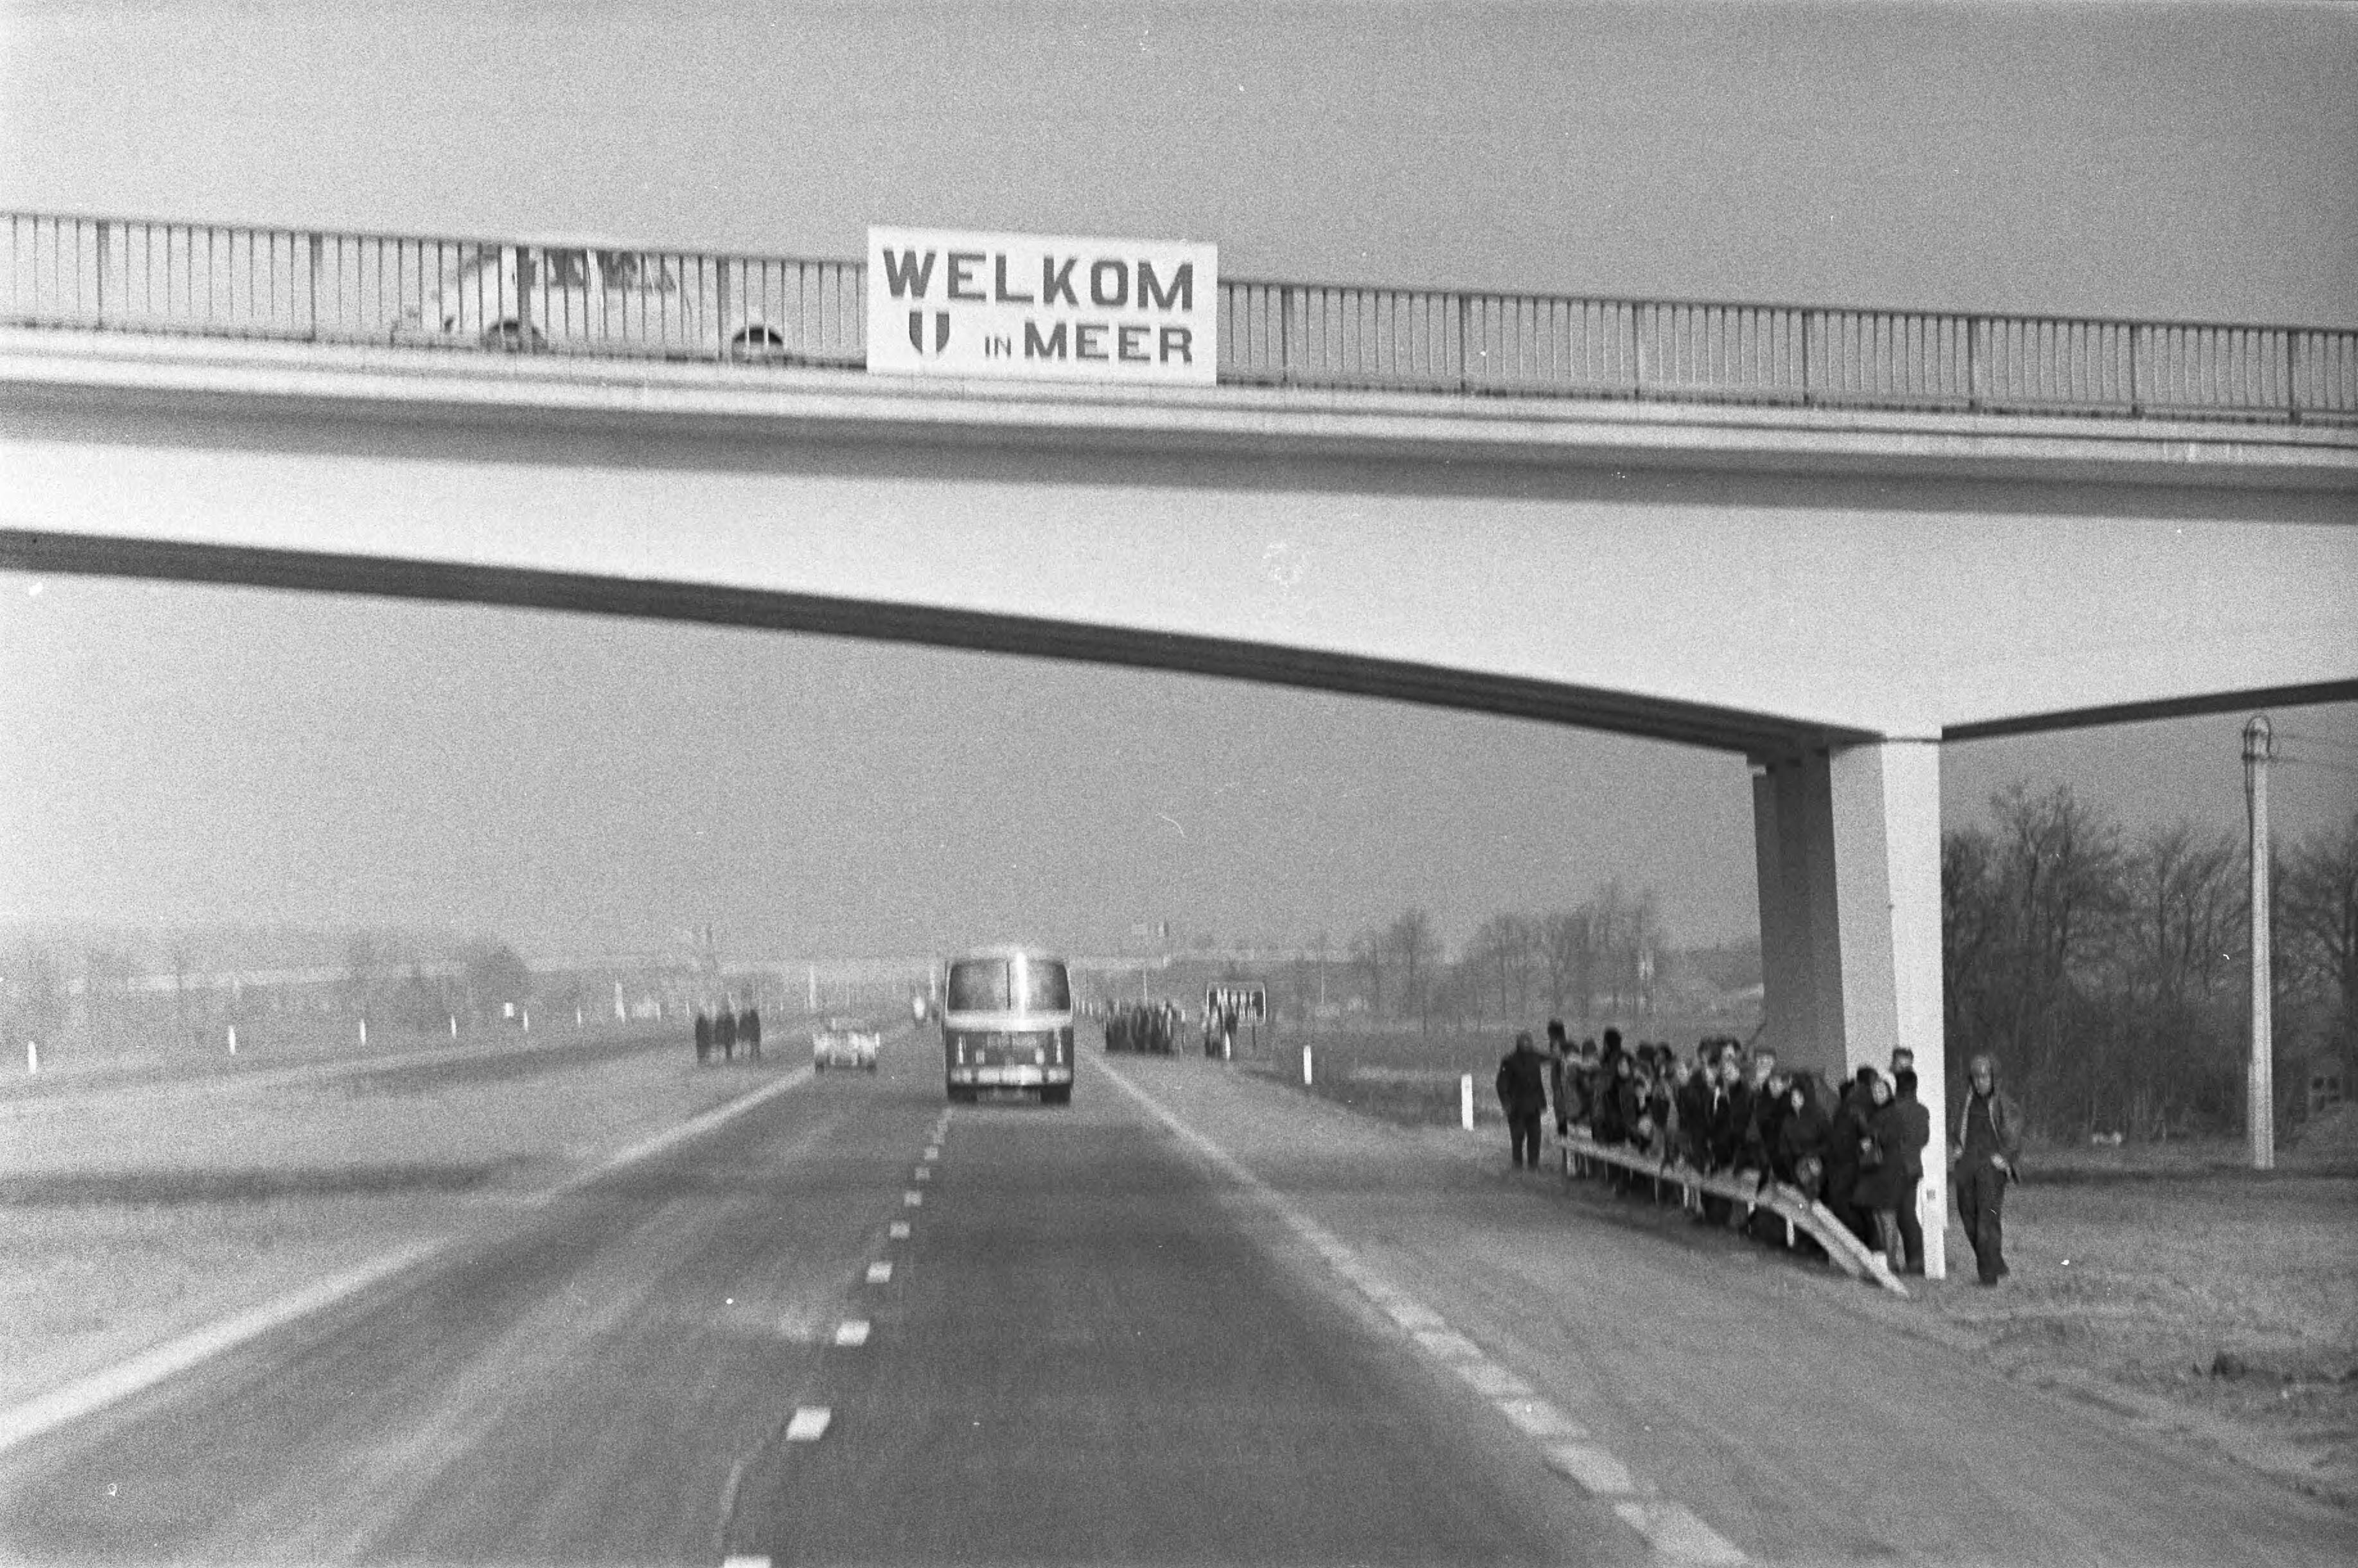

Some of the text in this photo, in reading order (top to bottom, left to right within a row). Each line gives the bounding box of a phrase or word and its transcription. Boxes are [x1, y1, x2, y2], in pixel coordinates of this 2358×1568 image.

[883, 248, 1193, 311] WELKOM
[985, 336, 1012, 358] IN
[1025, 321, 1193, 364] MEER
